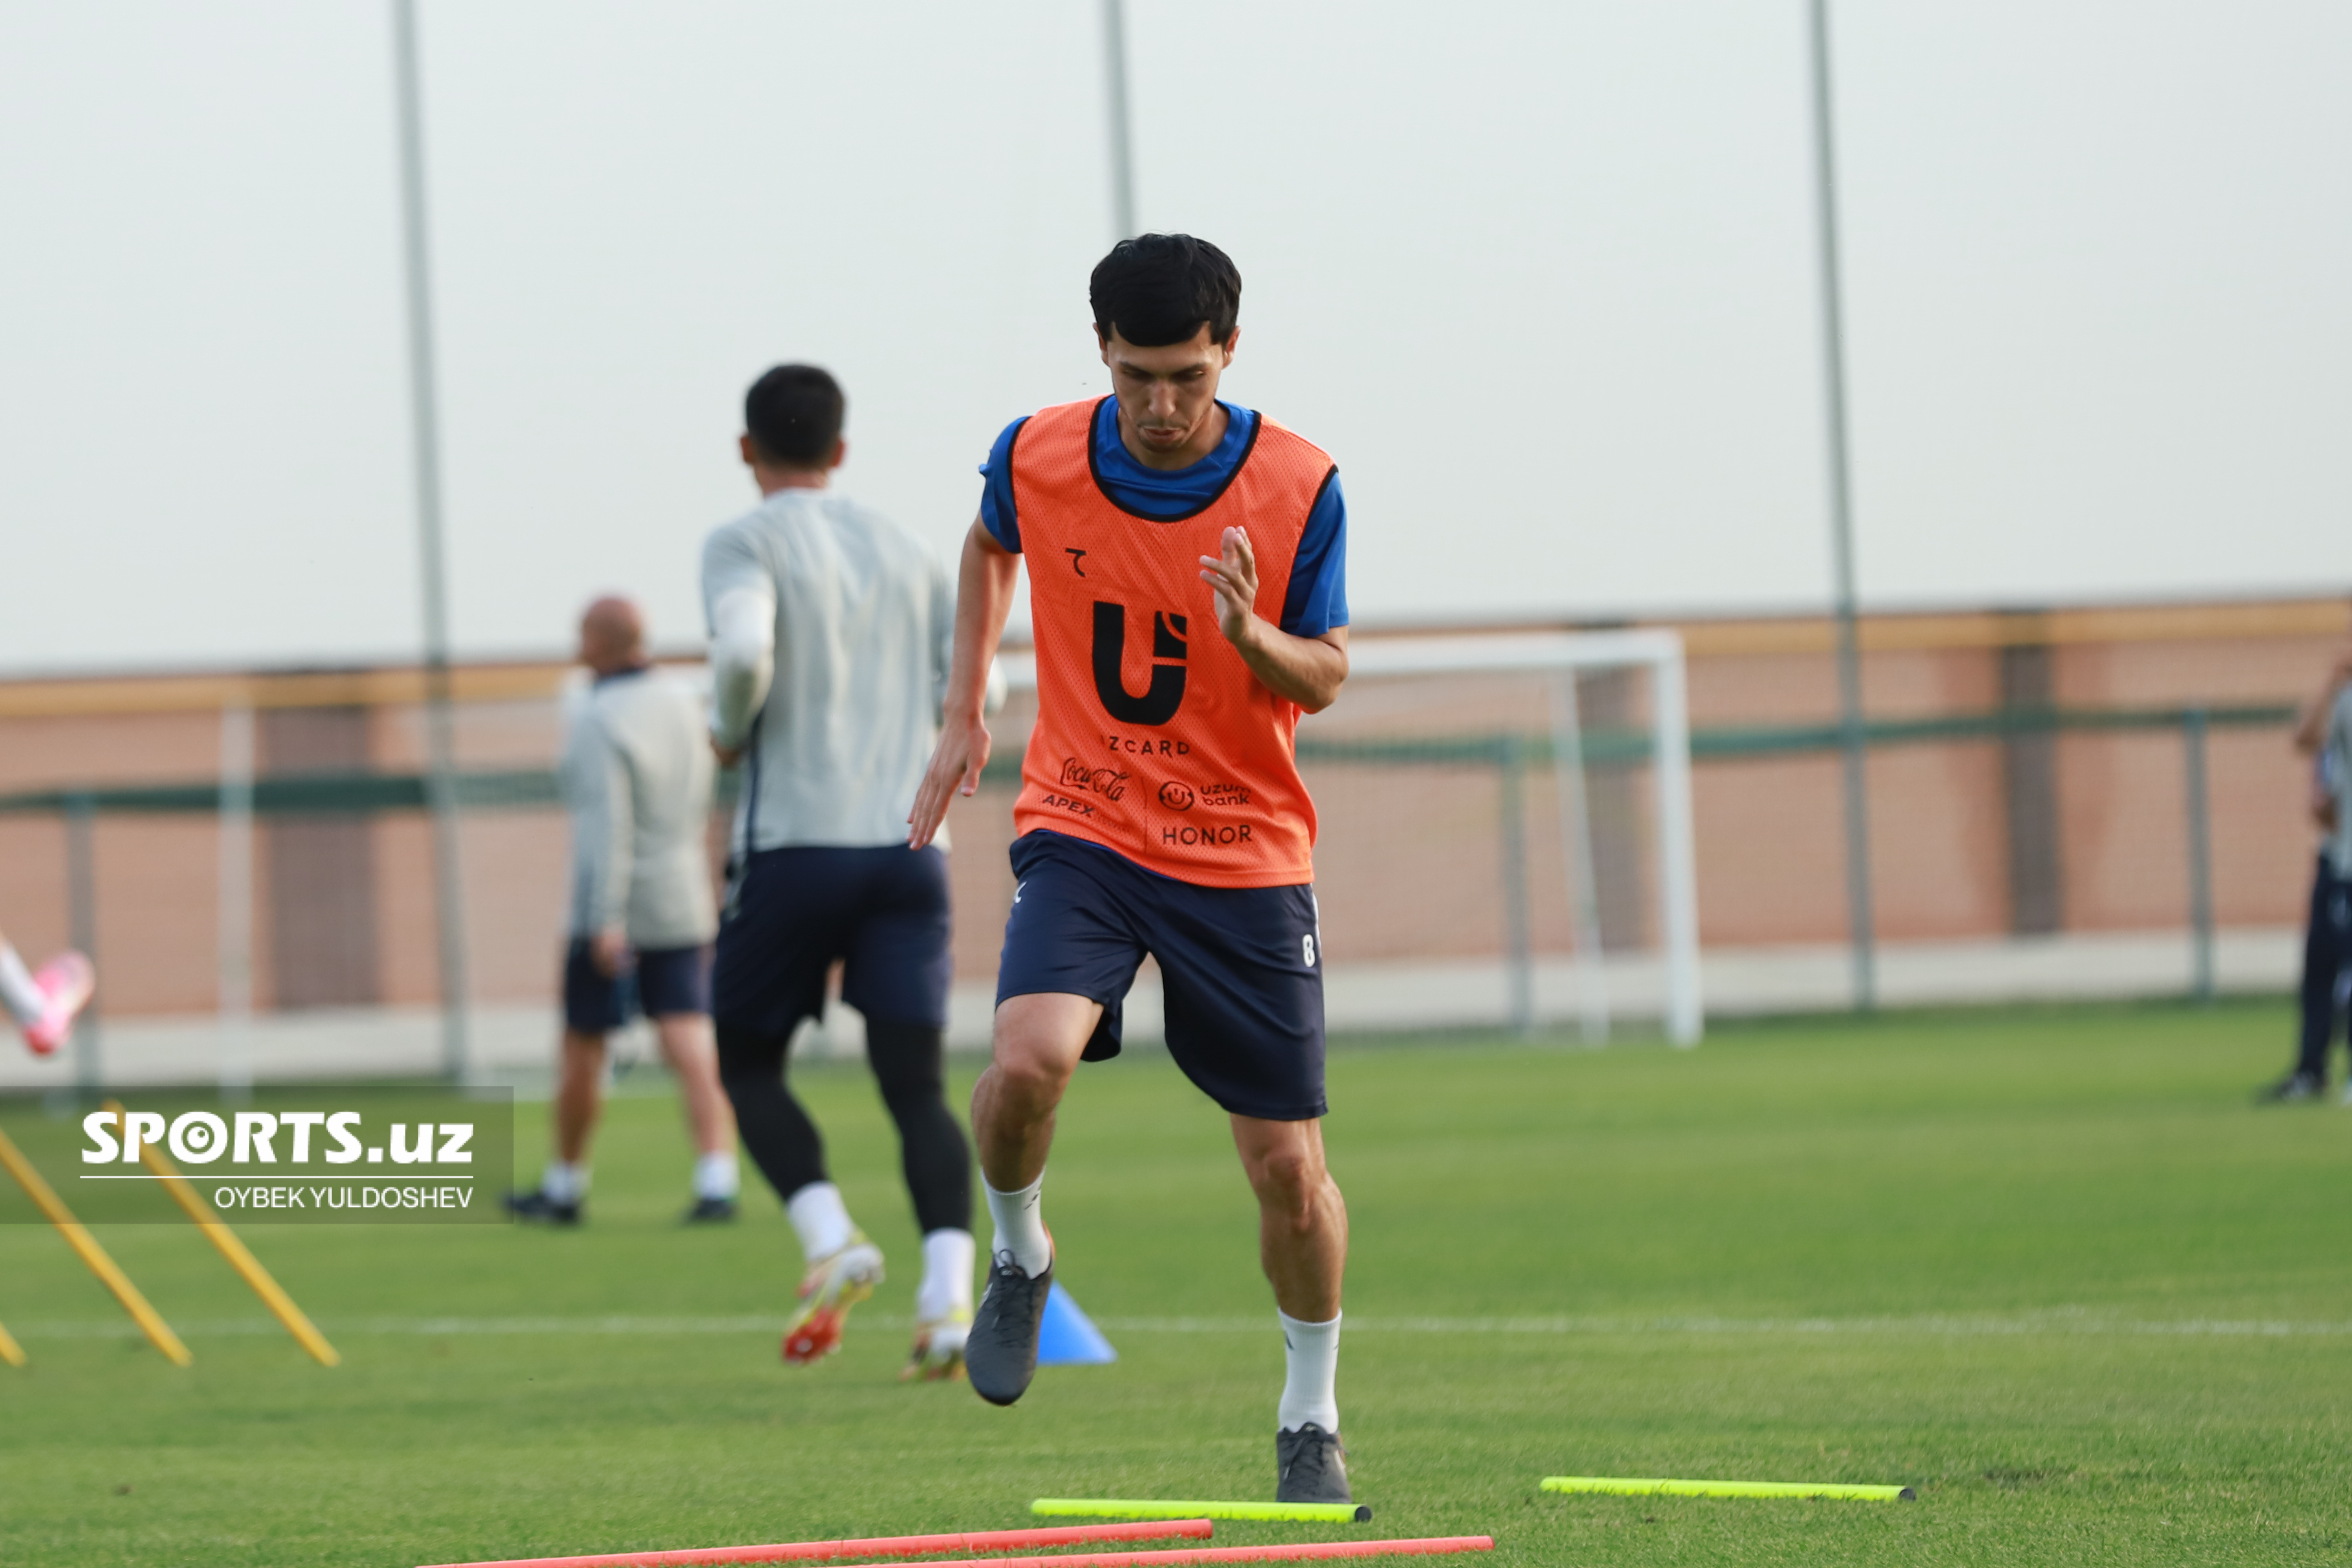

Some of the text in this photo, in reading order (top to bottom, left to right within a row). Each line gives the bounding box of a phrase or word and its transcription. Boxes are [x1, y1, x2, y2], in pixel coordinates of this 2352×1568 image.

[1099, 735, 1190, 758] ZCARD
[1042, 794, 1095, 818] APEX
[1202, 793, 1250, 805] bank
[1162, 824, 1252, 845] HONOR
[1302, 933, 1316, 968] 8
